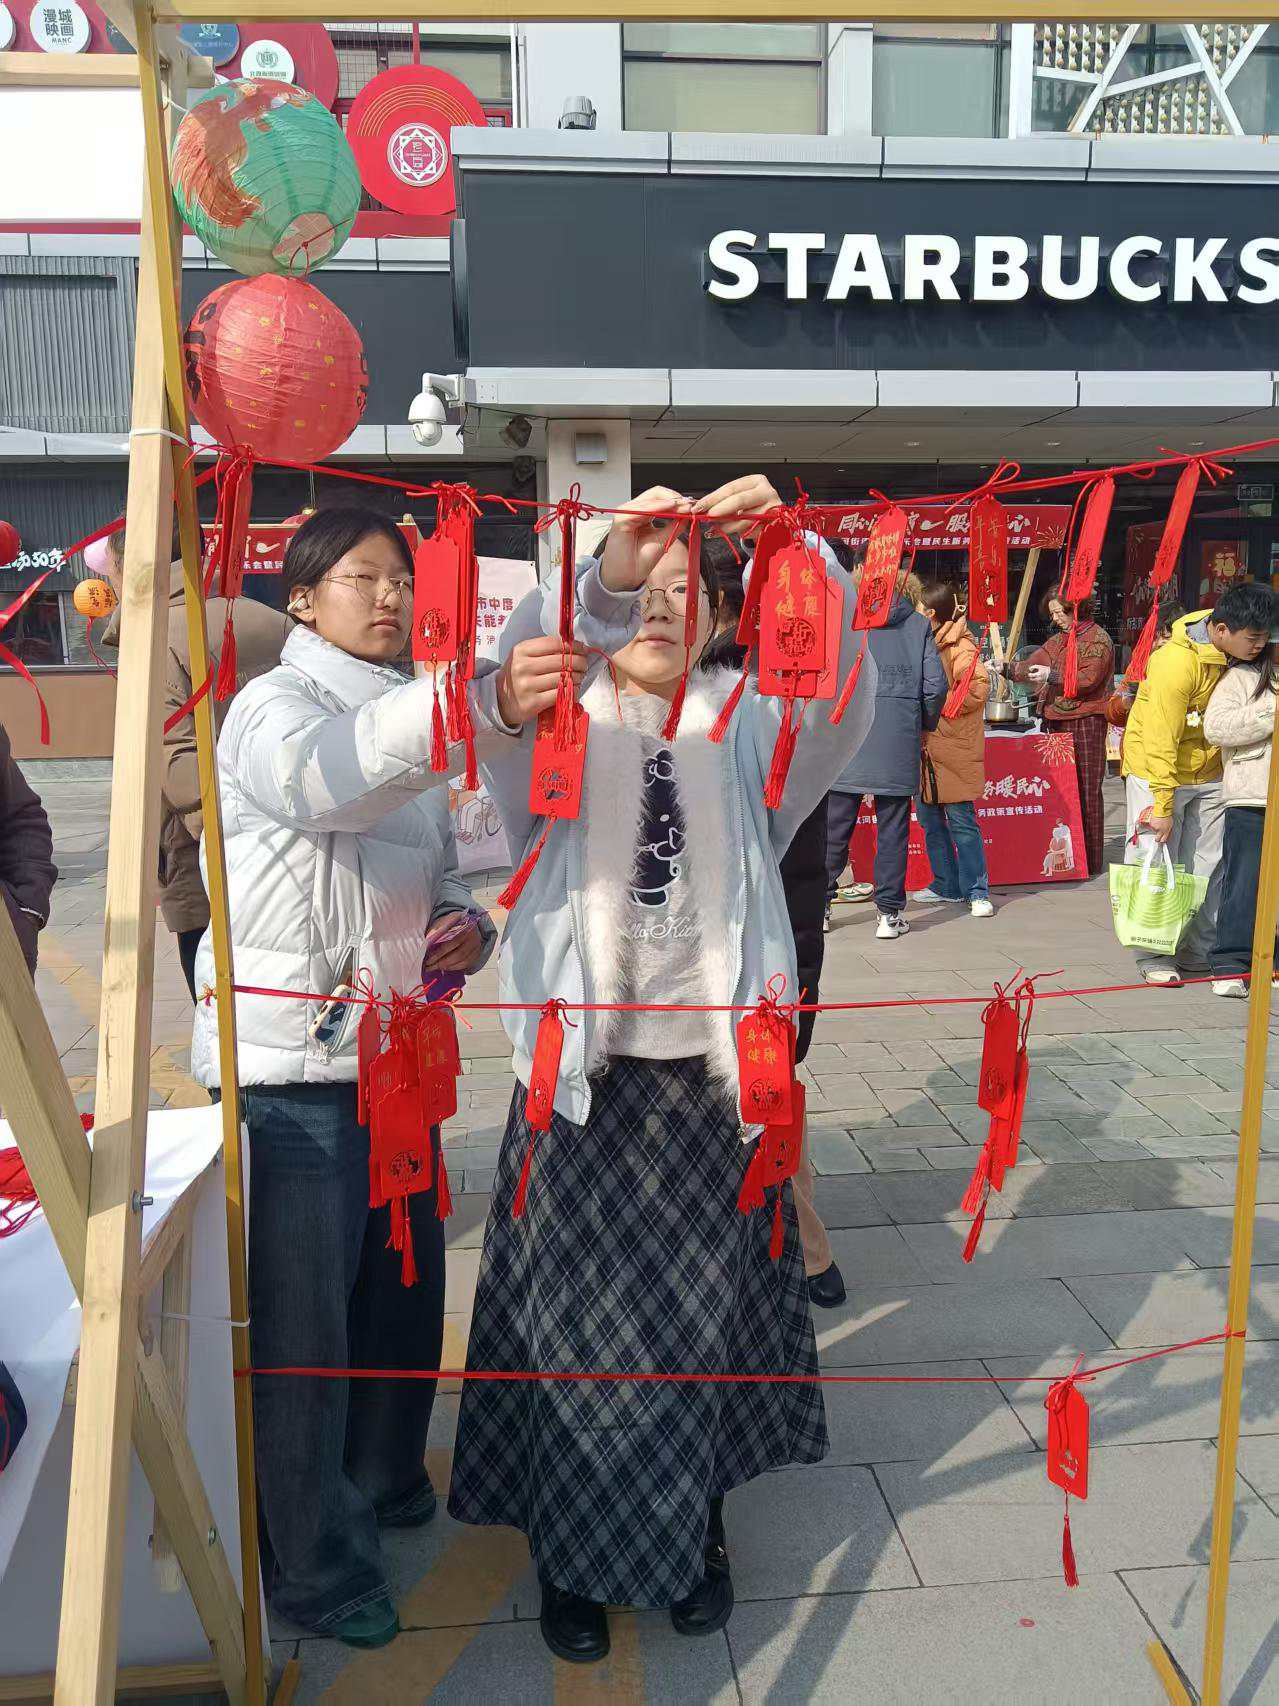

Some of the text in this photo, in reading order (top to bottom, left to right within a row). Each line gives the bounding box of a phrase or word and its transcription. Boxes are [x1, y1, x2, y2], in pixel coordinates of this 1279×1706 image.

[43, 8, 73, 23] 漫城
[45, 23, 74, 37] 映画
[706, 230, 1279, 304] STARBUCKS
